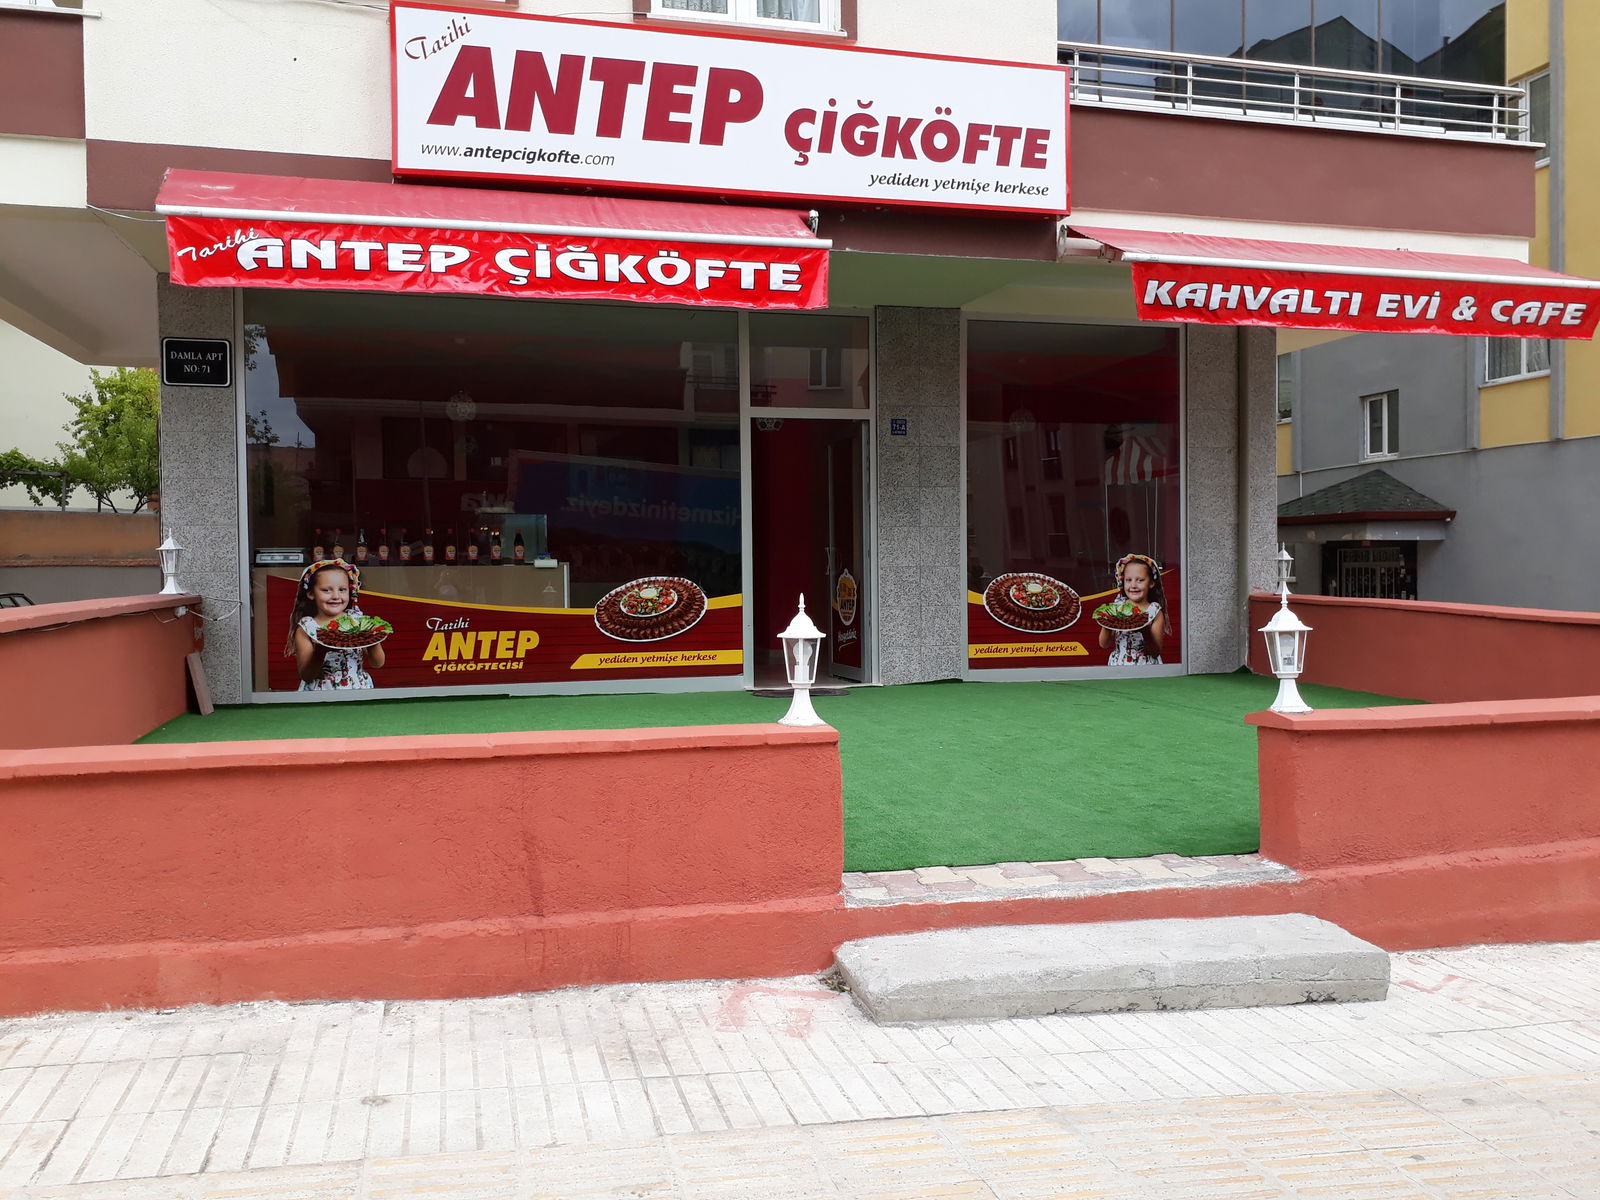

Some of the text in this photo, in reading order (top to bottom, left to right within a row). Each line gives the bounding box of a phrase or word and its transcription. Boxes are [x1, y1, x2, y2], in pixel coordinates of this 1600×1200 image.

[404, 16, 473, 60] Tarihi
[426, 44, 1051, 170] ANTEP ÇİĞKÖFTE
[421, 142, 615, 167] www.antepcigkofte.com
[868, 173, 1049, 196] yediden yetmişe herkese
[176, 227, 803, 292] Tarihi ANTEP ÇİĞKÖFTE
[1143, 279, 1588, 326] KAHVALTI EVİ & CAFE
[170, 351, 224, 361] DAMLA APT
[183, 364, 211, 374] NO: 71
[425, 617, 470, 631] Tarihi
[422, 630, 540, 661] ANTEP
[974, 643, 1078, 655] yediden yetmişe herkese
[433, 660, 524, 674] ÇİĞKÖFTECİSİ
[598, 653, 718, 666] yediden yetmişe herkese
